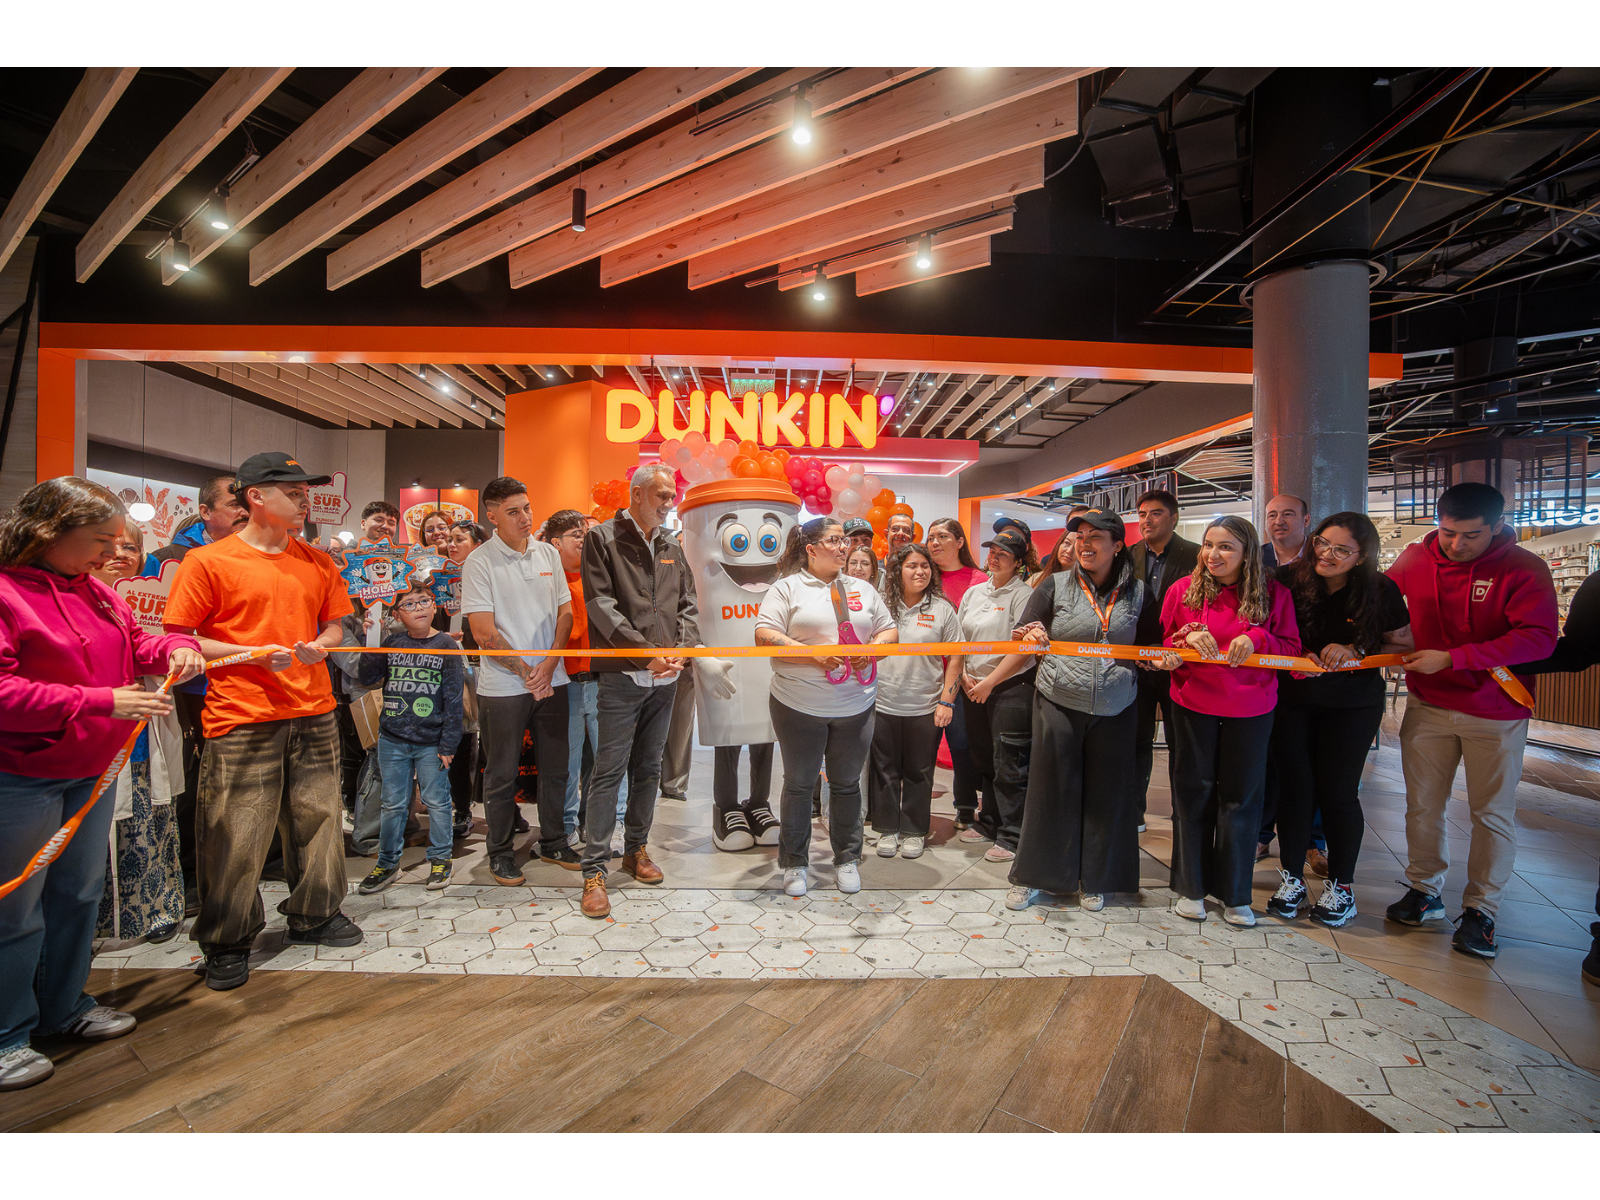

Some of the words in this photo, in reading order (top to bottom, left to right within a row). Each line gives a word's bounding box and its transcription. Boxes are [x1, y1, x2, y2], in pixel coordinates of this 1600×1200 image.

[313, 496, 341, 508] SUR
[126, 596, 166, 616] SUR
[444, 600, 461, 608] ¡HO
[722, 604, 760, 620] DUN
[1078, 646, 1113, 655] DUNKIN'
[416, 654, 444, 670] OFFER
[1259, 657, 1294, 668] DUNKIN'
[385, 681, 440, 694] RIDAY
